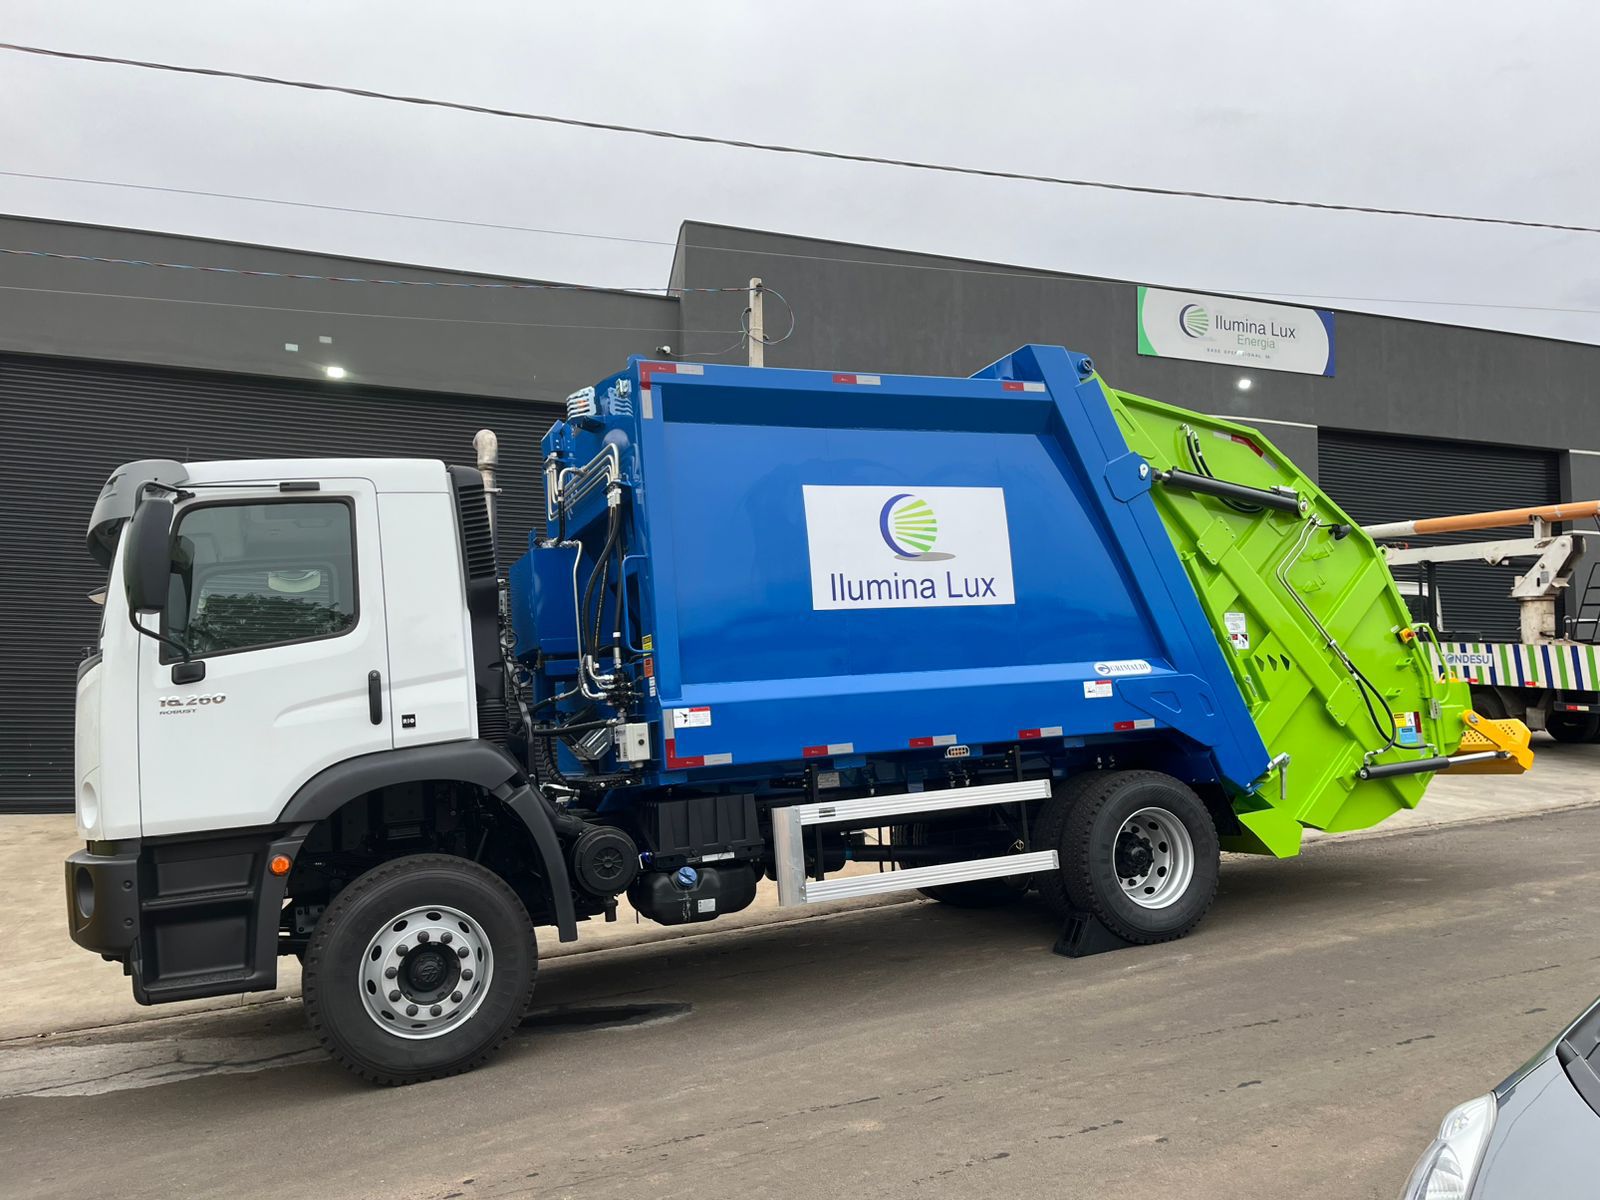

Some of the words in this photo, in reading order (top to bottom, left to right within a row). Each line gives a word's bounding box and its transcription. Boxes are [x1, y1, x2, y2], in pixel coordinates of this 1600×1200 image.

[1215, 315, 1266, 336] Ilumina
[1271, 322, 1296, 339] Lux
[1237, 334, 1275, 350] Energia
[830, 572, 936, 601] Ilumina
[946, 571, 997, 598] Lux
[1442, 653, 1490, 664] ONDESU
